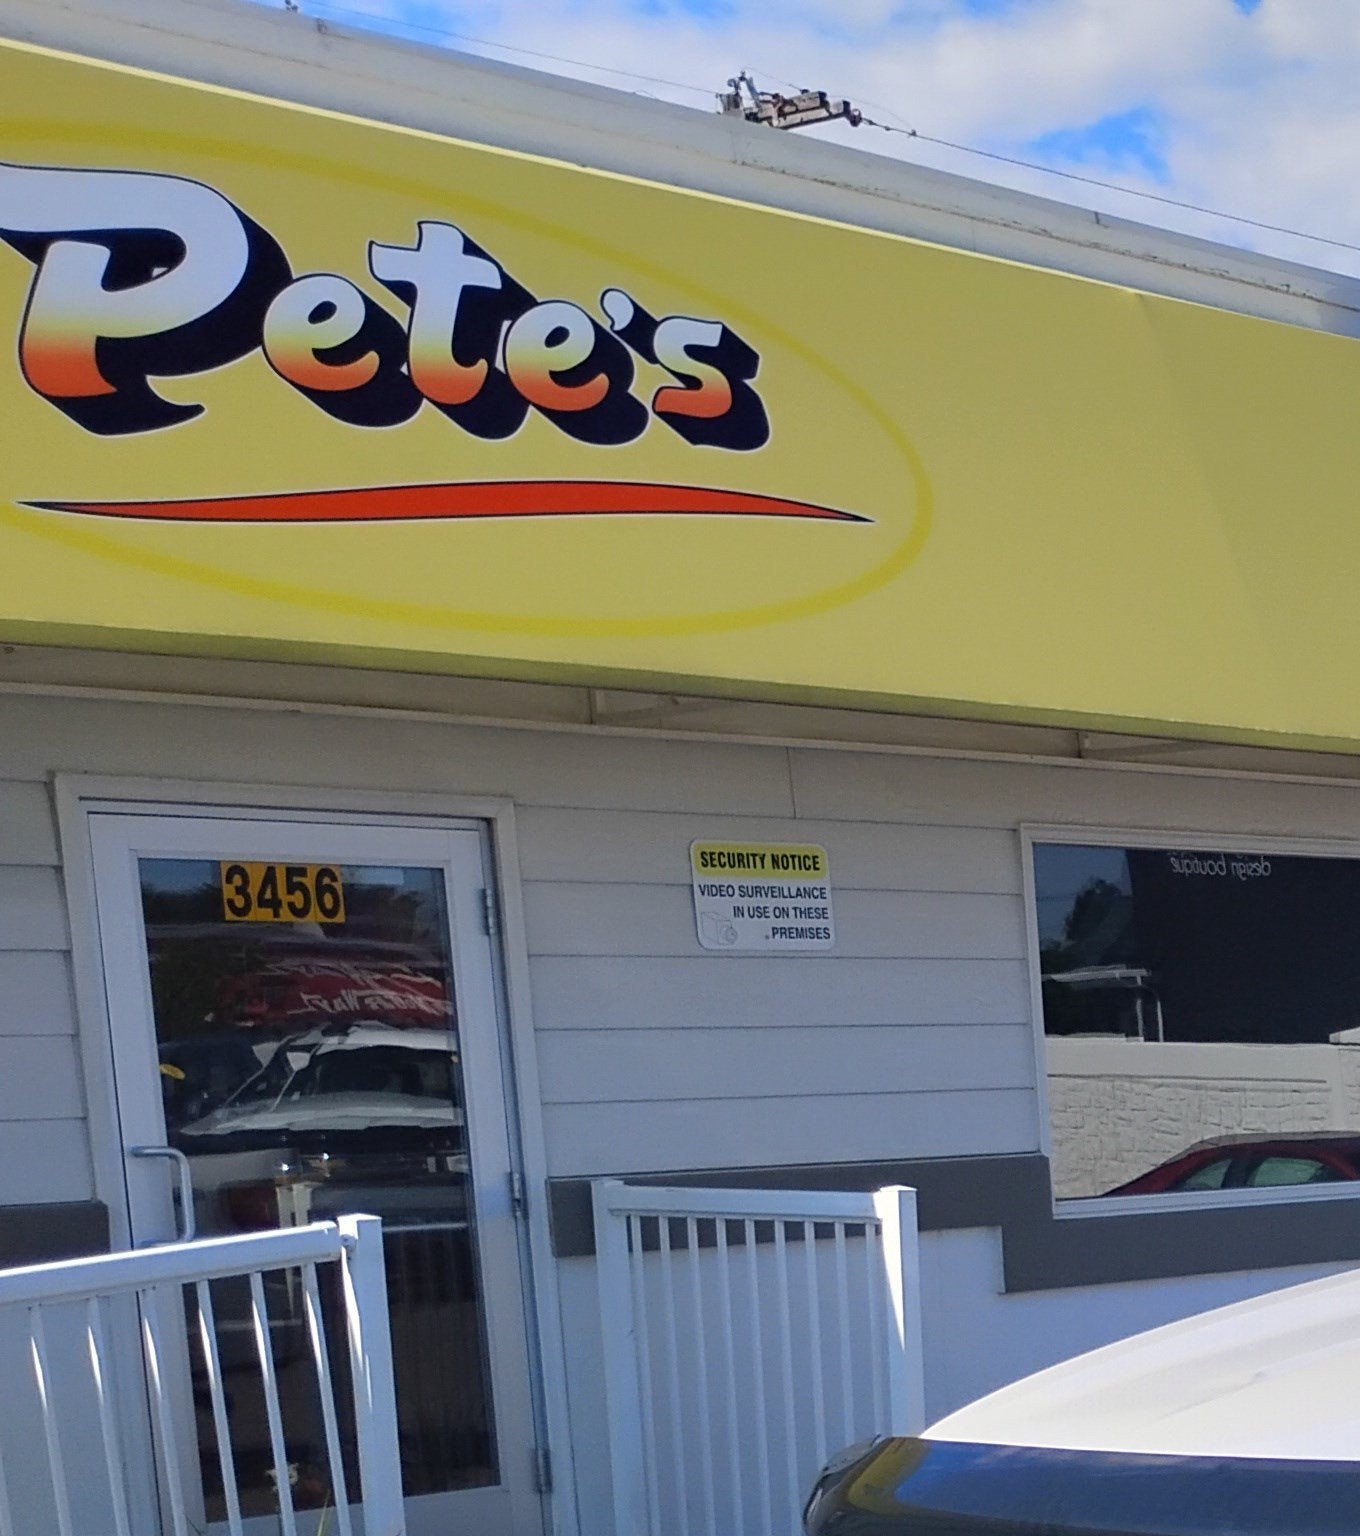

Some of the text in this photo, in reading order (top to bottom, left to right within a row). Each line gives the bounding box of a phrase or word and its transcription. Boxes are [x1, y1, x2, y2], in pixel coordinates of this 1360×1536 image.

[0, 163, 770, 450] Pete's
[700, 851, 821, 871] SECURITY NOTICE
[225, 864, 341, 919] 3456
[699, 884, 828, 900] VIDEO SURVEILLANCE
[733, 905, 829, 920] IN USE ON THESE
[771, 926, 831, 940] PREMISES
